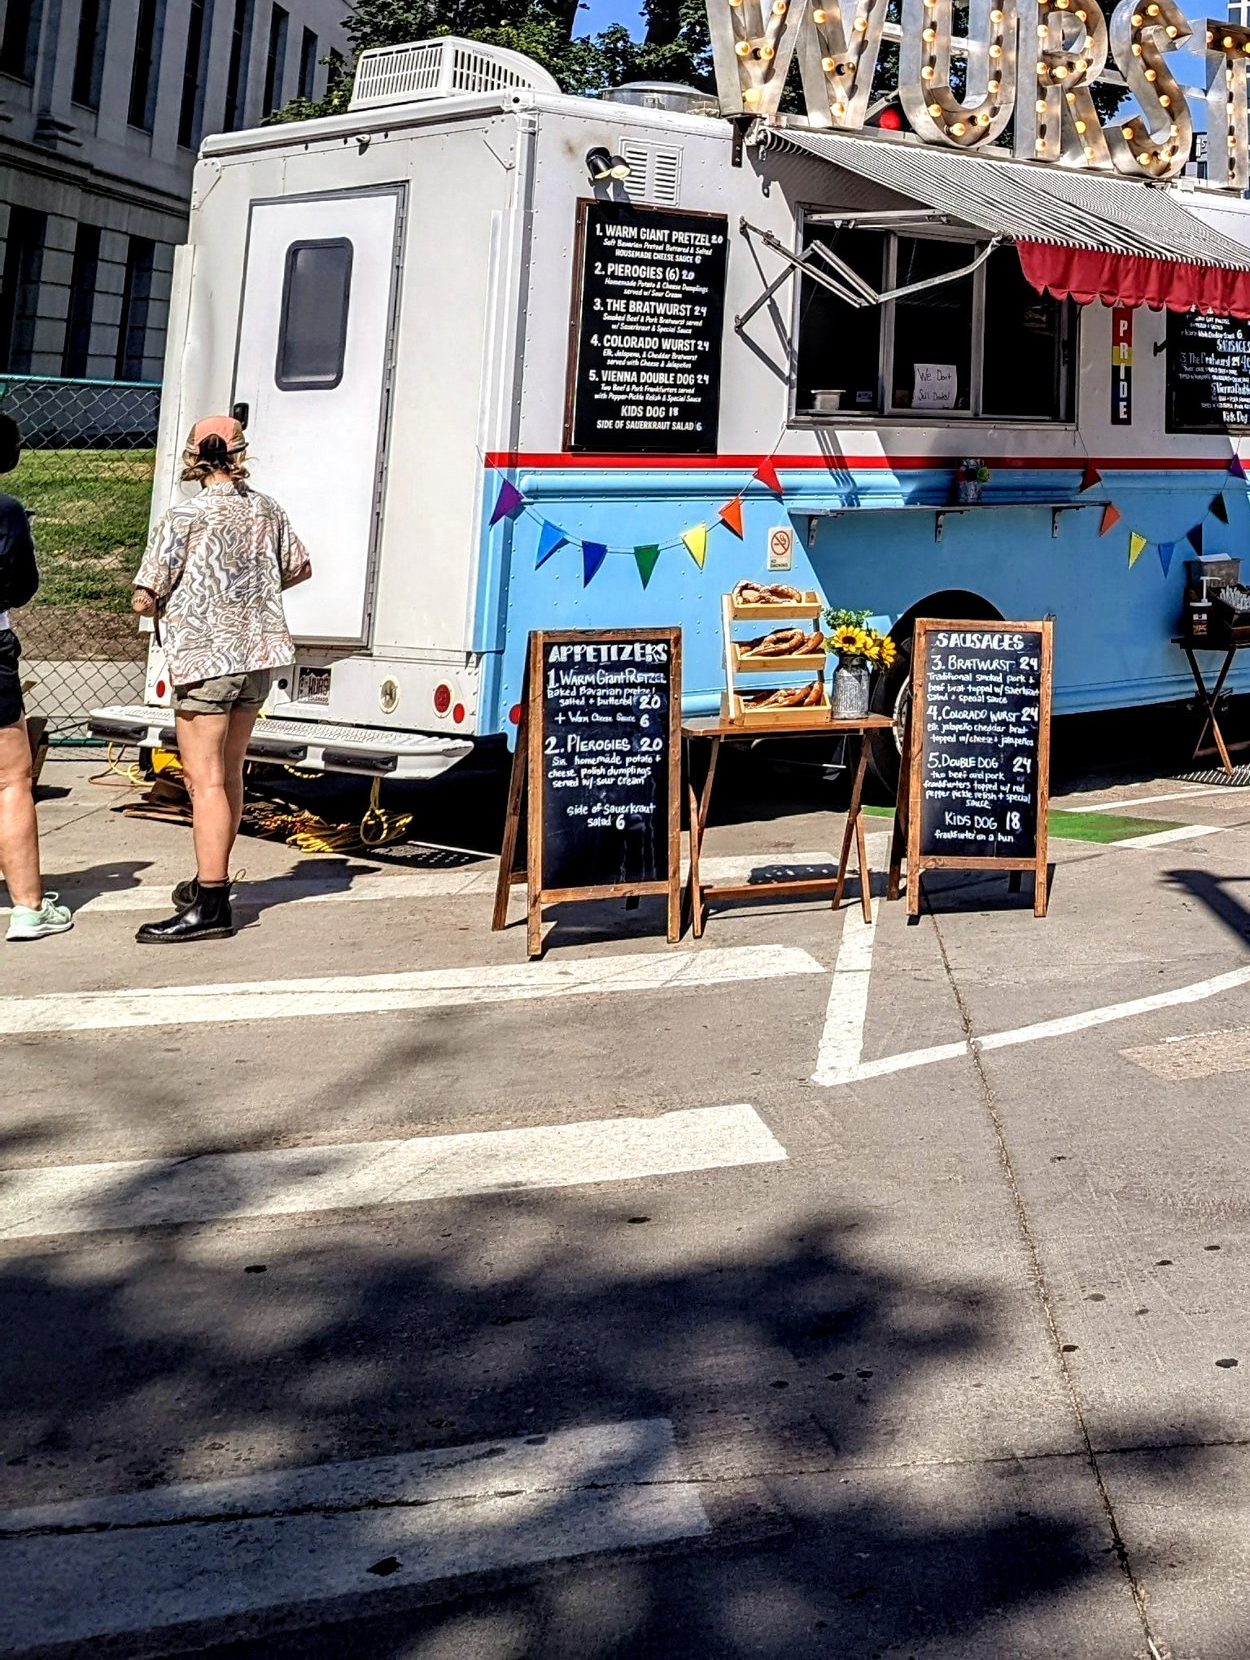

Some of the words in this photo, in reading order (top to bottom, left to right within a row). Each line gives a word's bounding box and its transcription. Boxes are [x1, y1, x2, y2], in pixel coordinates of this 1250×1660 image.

[595, 224, 602, 236] 1.
[606, 224, 637, 238] WARM
[640, 228, 669, 242] GIANT
[672, 232, 711, 246] PRETZEL
[603, 238, 616, 246] Soft
[618, 240, 642, 248] Bavarian
[644, 242, 663, 250] Pretzel
[666, 245, 689, 253] Buttered
[616, 249, 652, 259] HOUSEMADE
[653, 253, 674, 261] CHEESE
[675, 255, 693, 263] SAUCE
[595, 262, 605, 274] 2.
[608, 263, 662, 279] PIEROGIES
[666, 268, 679, 281] (6)
[605, 278, 636, 287] Homemade
[682, 284, 708, 294] Dumplings
[593, 298, 603, 310] 3.
[606, 299, 626, 312] THE
[629, 301, 691, 316] BRATWURST
[694, 306, 707, 316] 24
[603, 313, 624, 321] Smoked
[620, 323, 650, 331] Sauerkraut
[657, 326, 675, 334] Special
[591, 334, 601, 346] 4.
[604, 335, 658, 349] COLORADO
[662, 338, 696, 351] WURST
[697, 341, 709, 351] 24
[1119, 320, 1128, 419] PRIDE
[589, 370, 598, 381] 5.
[602, 370, 637, 382] VIENNA
[640, 372, 674, 384] DOUBLE
[677, 374, 694, 384] DOG
[697, 374, 709, 384] 24
[644, 385, 677, 393] Frankfurters
[668, 395, 685, 403] Special
[621, 405, 643, 417] KIDS
[646, 406, 665, 417] DOG
[669, 407, 678, 416] 18
[597, 420, 613, 428] SIDE
[615, 421, 624, 429] OF
[626, 421, 670, 430] SAUERKRAUT
[672, 422, 694, 430] SALAD
[696, 423, 702, 431] 6
[936, 632, 1024, 650] SAUSAGES
[548, 643, 668, 664] APPETIZERS
[931, 655, 945, 670] 3.
[1019, 656, 1038, 670] 24
[580, 686, 622, 696] Bavarian
[639, 696, 660, 709] 20
[640, 714, 649, 727] 6
[1021, 707, 1038, 721] 24
[544, 736, 564, 754] 2.
[567, 734, 631, 752] PIEROGIES
[640, 738, 662, 752] 20
[574, 752, 622, 764] homemade
[626, 755, 652, 766] potato
[978, 757, 999, 768] DOG
[1012, 756, 1032, 773] 24
[548, 769, 577, 778] cheese
[607, 766, 651, 778] dumplings
[552, 778, 578, 788] served
[616, 814, 625, 830] 6
[974, 816, 998, 829] DOG
[1006, 811, 1020, 830] 18
